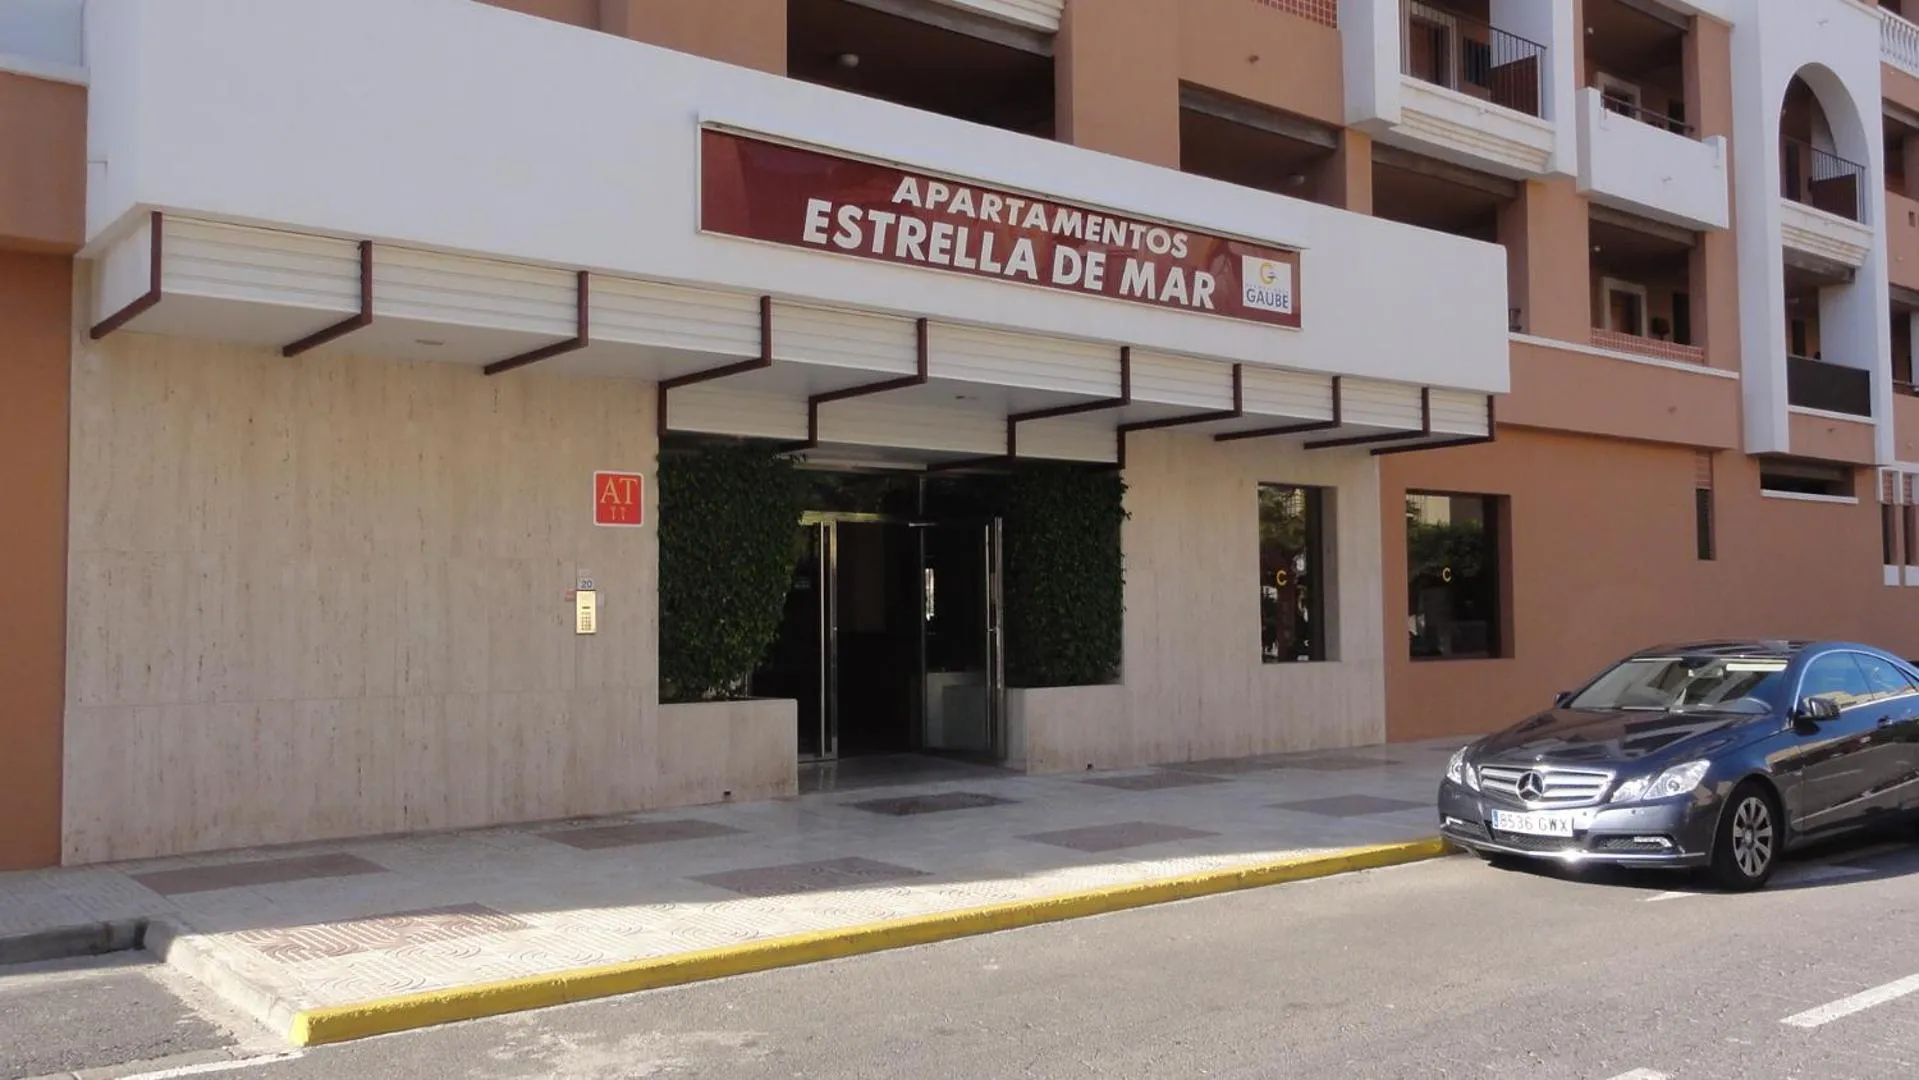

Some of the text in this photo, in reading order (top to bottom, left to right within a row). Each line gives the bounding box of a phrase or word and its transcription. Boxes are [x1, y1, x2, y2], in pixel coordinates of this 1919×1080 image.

[892, 176, 1189, 259] APARTAMENTOS
[802, 198, 1216, 310] ESTRELLA DE MAR
[1246, 288, 1289, 309] GAUBE
[599, 477, 638, 505] AT
[580, 579, 593, 589] 20
[1499, 813, 1568, 832] 8536 GWX
